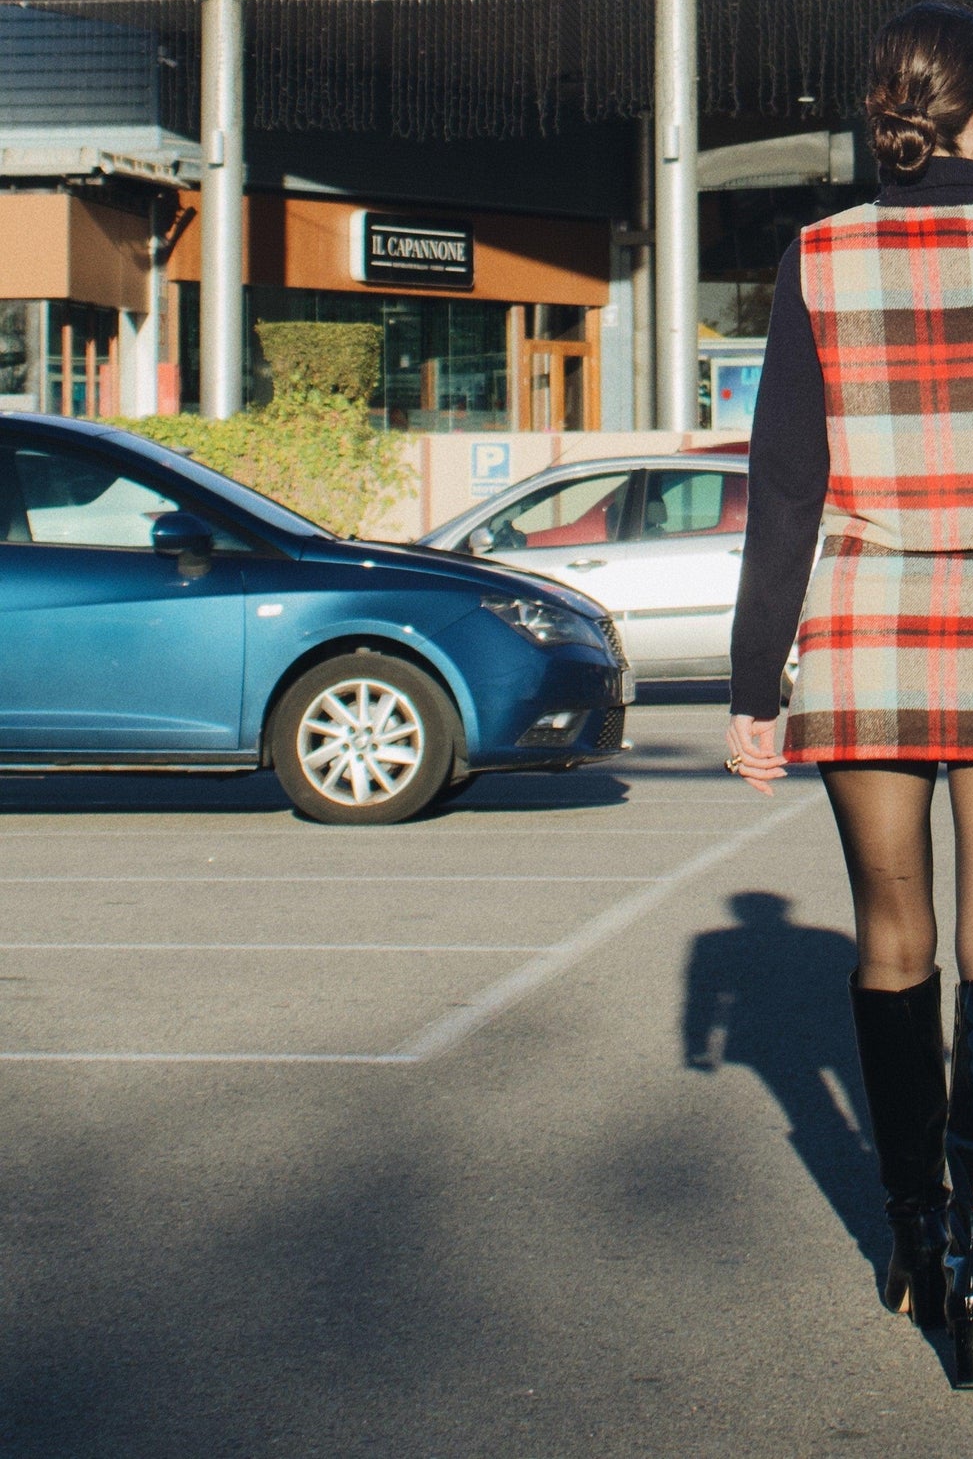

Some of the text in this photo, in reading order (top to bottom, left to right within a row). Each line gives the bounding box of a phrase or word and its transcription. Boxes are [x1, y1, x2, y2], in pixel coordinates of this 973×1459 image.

[372, 234, 465, 262] IL CAPANNONE
[476, 445, 505, 477] P
